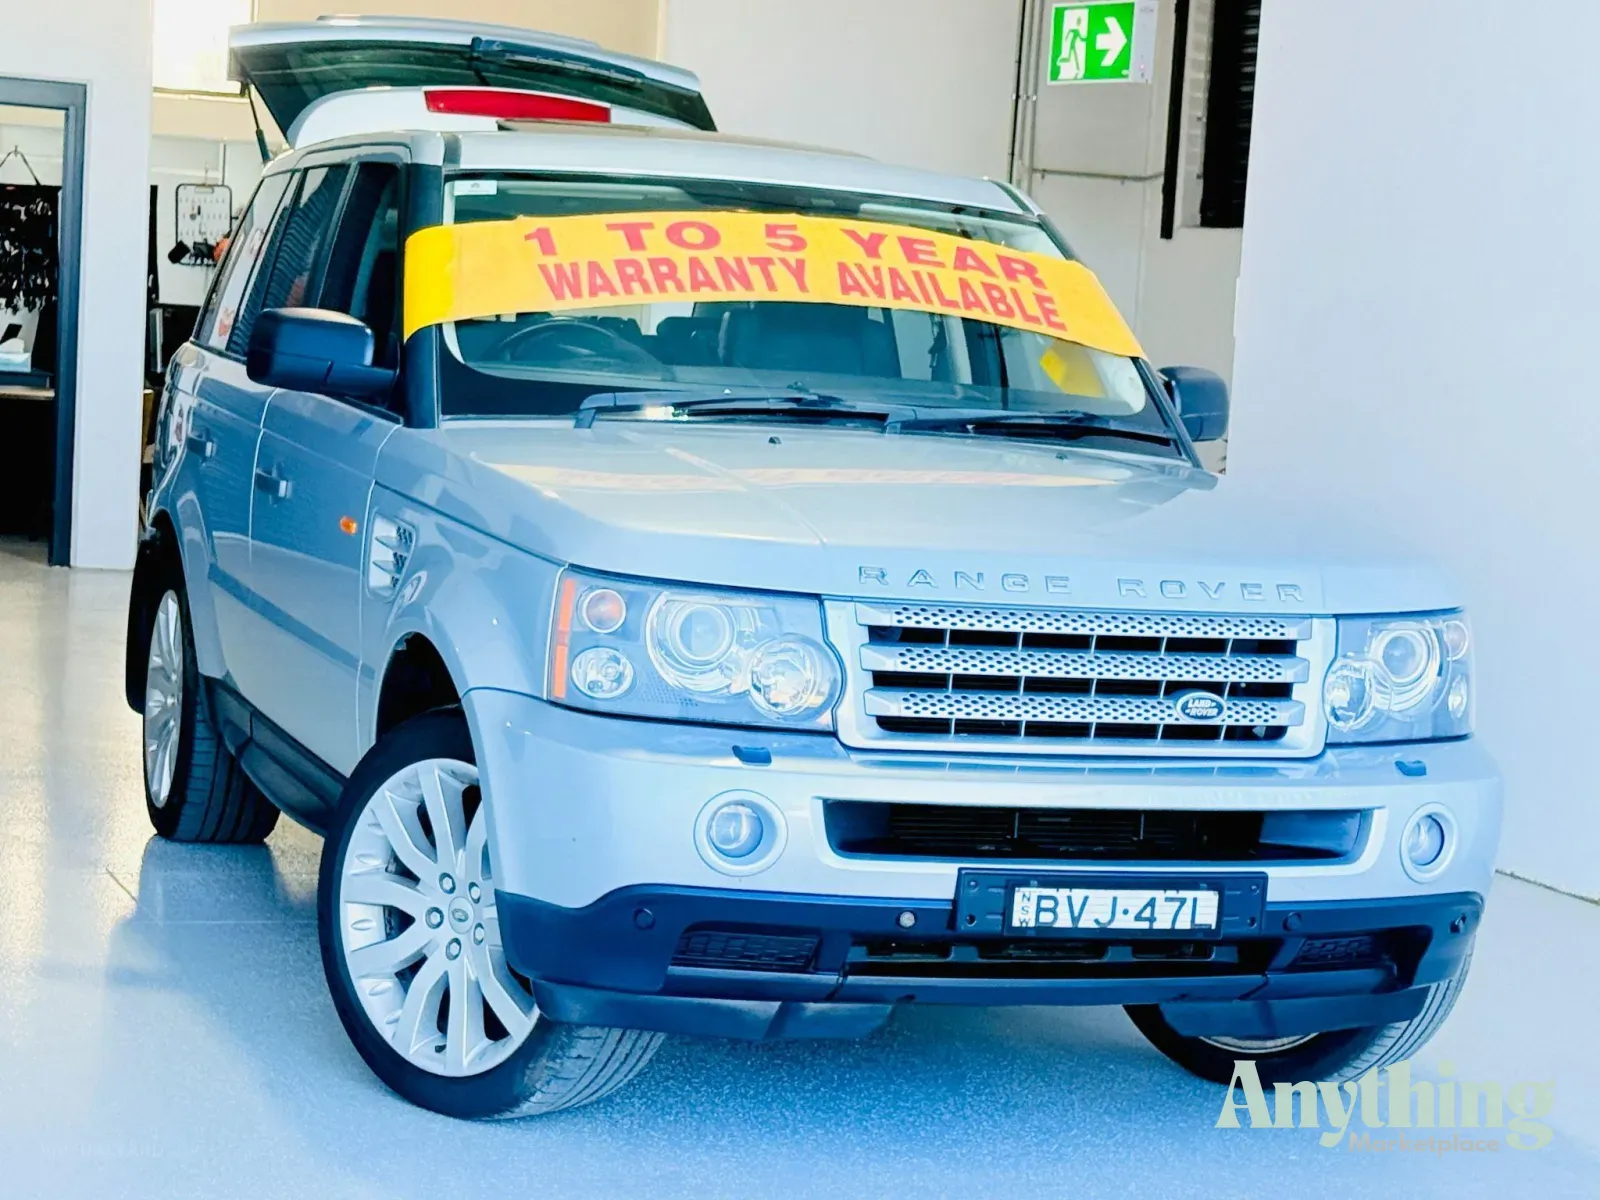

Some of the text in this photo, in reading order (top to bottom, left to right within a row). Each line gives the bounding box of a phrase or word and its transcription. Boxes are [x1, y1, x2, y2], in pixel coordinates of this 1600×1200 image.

[524, 221, 1048, 290] 1 TO 5 YEAR
[537, 256, 1068, 332] WARRANTY AVAILABLE
[858, 565, 1305, 603] RANGE ROVER
[1187, 699, 1212, 708] LAND
[1189, 707, 1219, 717] ROVER
